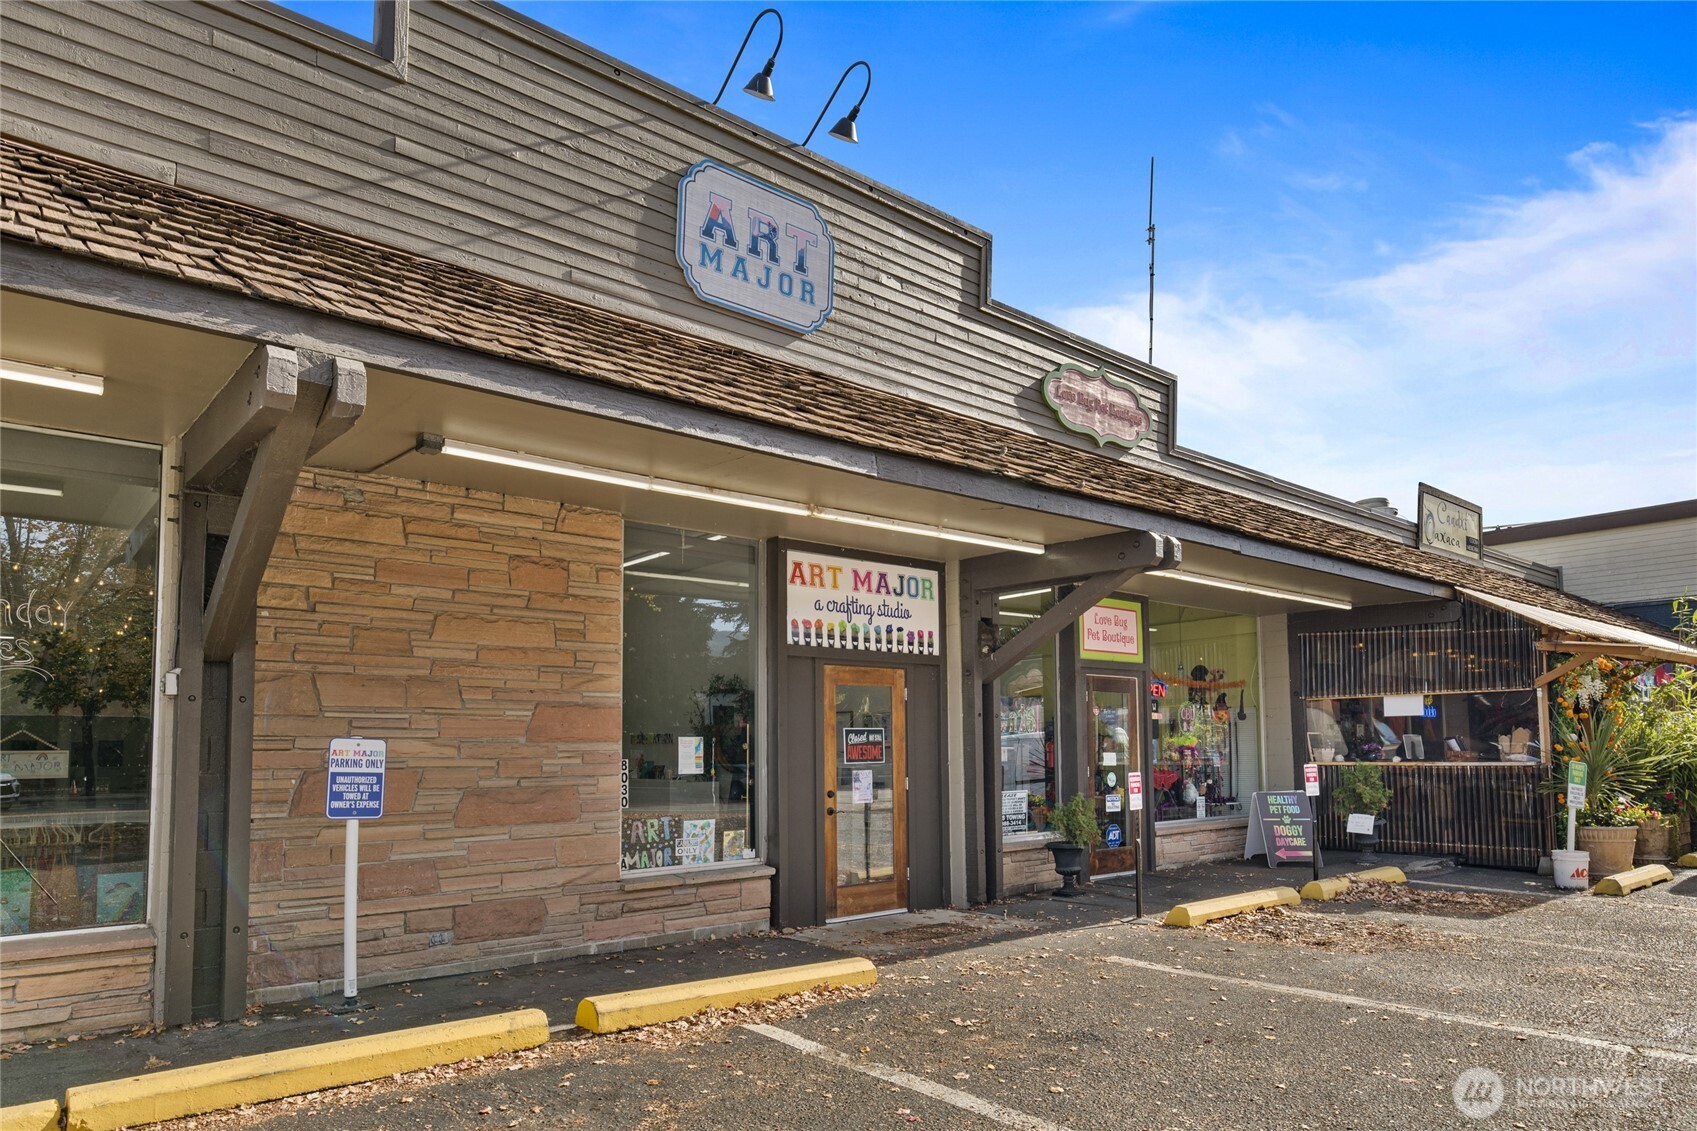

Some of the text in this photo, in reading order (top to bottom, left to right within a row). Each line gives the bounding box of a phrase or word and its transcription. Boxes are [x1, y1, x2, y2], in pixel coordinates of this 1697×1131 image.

[700, 191, 818, 277] ART
[699, 243, 816, 305] MAJOR
[1424, 509, 1461, 548] Oaxaca
[789, 560, 935, 600] ART MAJOR
[814, 595, 912, 625] a crafting studio
[1094, 612, 1128, 631] Love Bug
[1087, 627, 1135, 647] Pet Boutique
[331, 749, 384, 757] ART MAJOR
[847, 745, 883, 760] AWESOME
[14, 761, 62, 773] MAJOR
[330, 758, 384, 769] PARKING ONLY
[335, 776, 377, 784] UNAUTHORIZED
[332, 784, 380, 792] VEHICLES WILL BE
[342, 792, 370, 800] TOWED AT
[1267, 795, 1297, 804] HEALTHY
[330, 800, 380, 809] OWNER'S EXPENSE
[1269, 805, 1301, 814] PET FOOD
[630, 816, 673, 844] ART
[1108, 830, 1120, 841] ADT
[1273, 825, 1303, 836] DOGGY
[1275, 837, 1307, 847] DAYCARE
[677, 847, 697, 855] ONLY
[626, 847, 673, 869] MAJOR
[1570, 867, 1588, 878] AC
